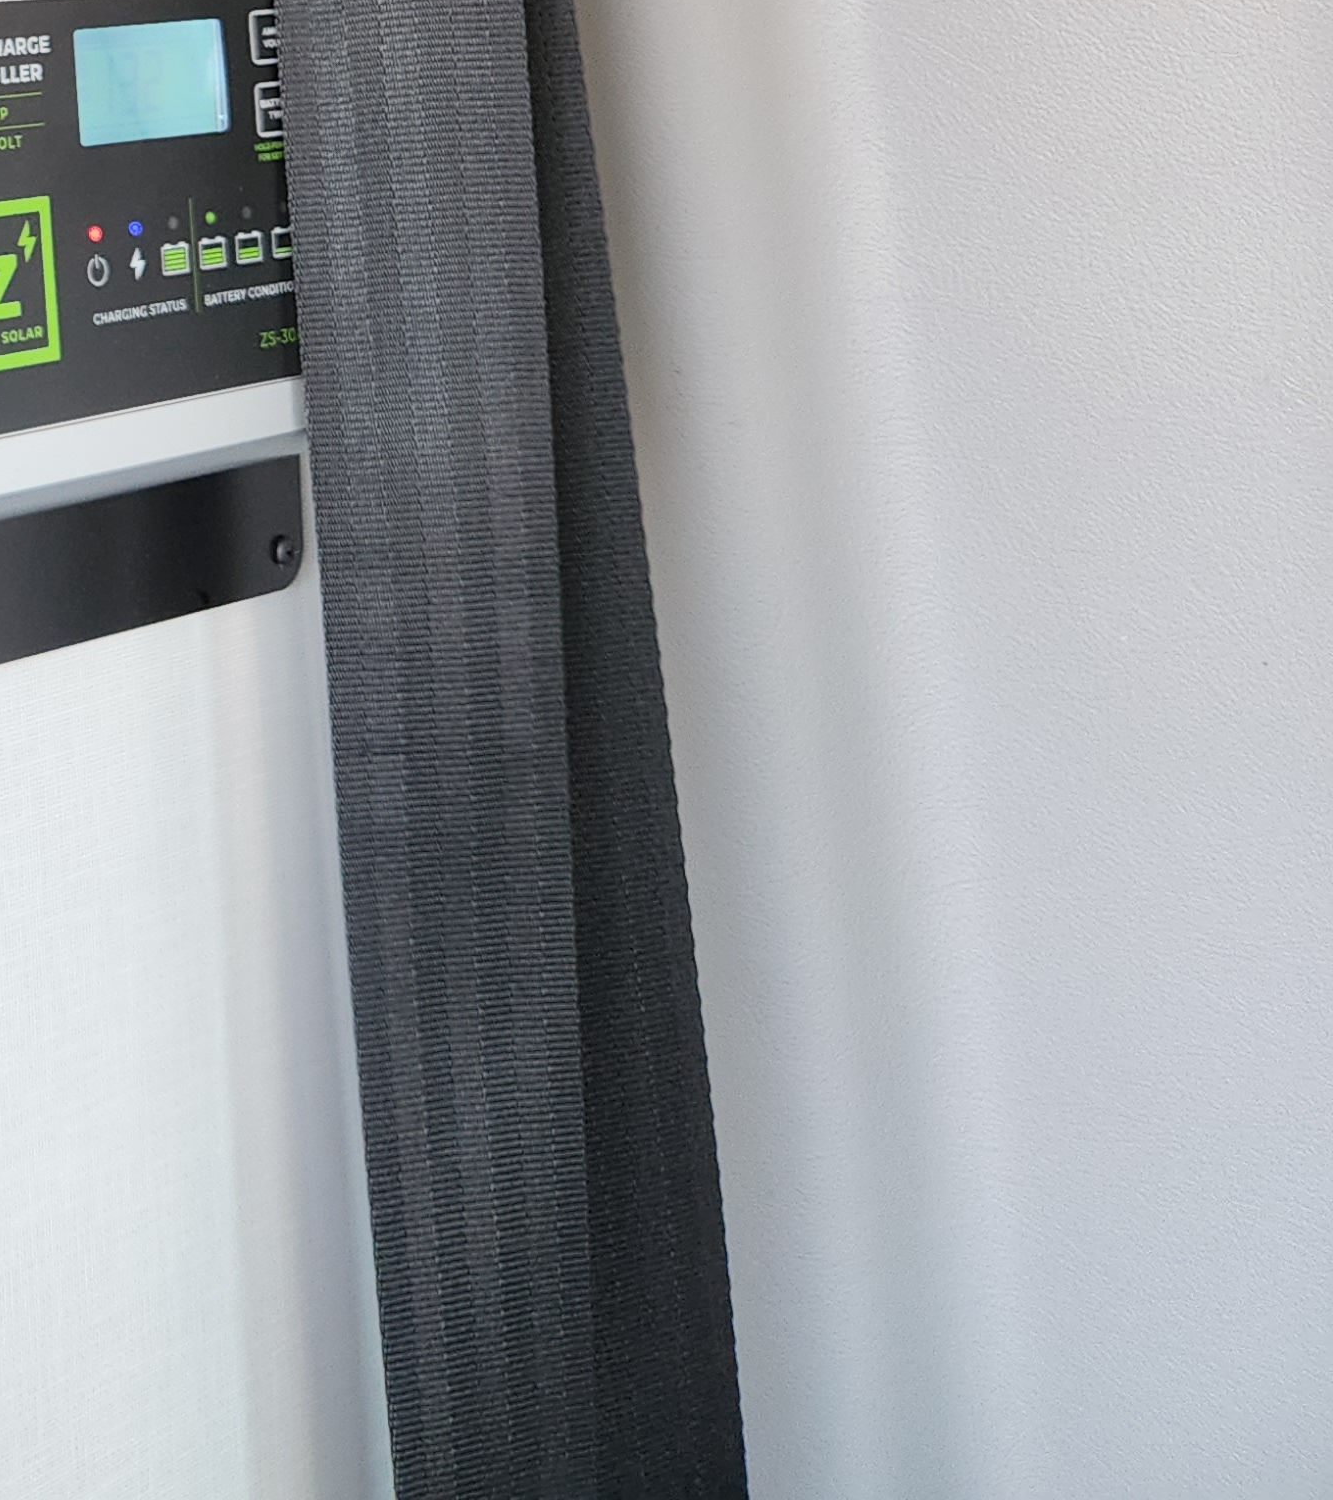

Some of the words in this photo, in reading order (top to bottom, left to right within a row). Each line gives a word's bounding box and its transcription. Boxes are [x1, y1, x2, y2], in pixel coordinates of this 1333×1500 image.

[204, 288, 246, 306] BATTERY
[247, 280, 296, 299] CONDITIO
[92, 305, 148, 326] CHARGING
[148, 298, 187, 316] STATUS
[1, 325, 43, 346] SOLAR
[259, 327, 298, 348] ZS-30
